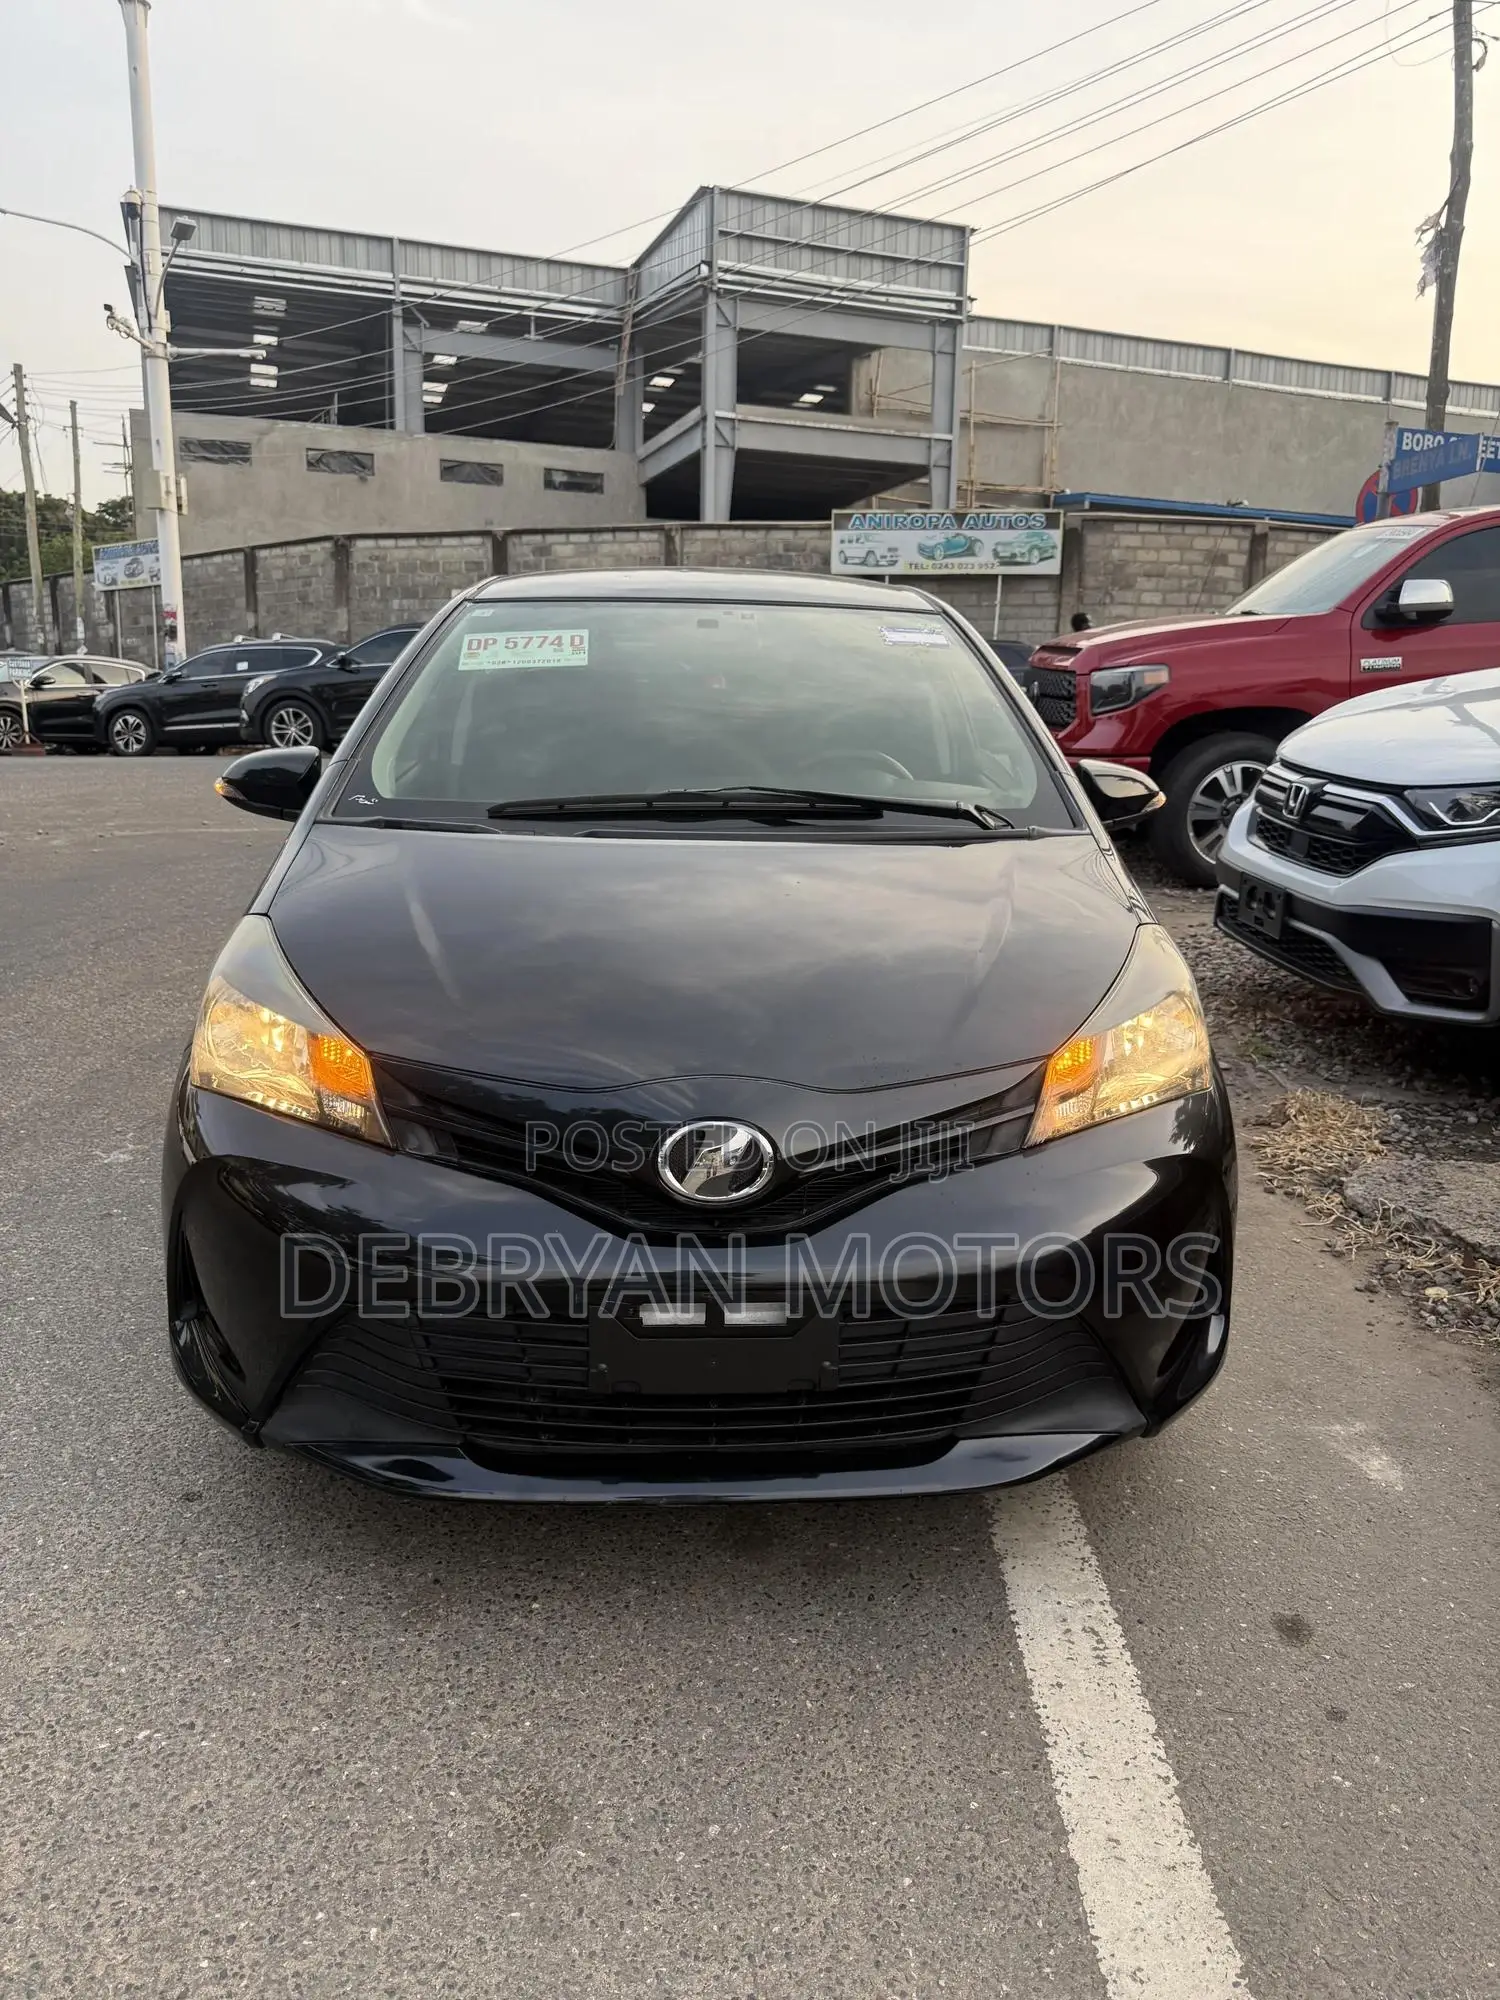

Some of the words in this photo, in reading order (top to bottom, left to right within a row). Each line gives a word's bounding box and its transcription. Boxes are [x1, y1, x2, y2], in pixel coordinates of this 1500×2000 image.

[849, 513, 956, 530] ANIROPA
[961, 513, 1048, 530] AUTOS
[908, 562, 929, 571] TEL:
[931, 562, 954, 570] 0243
[467, 637, 498, 651] DP
[504, 635, 564, 650] 5774
